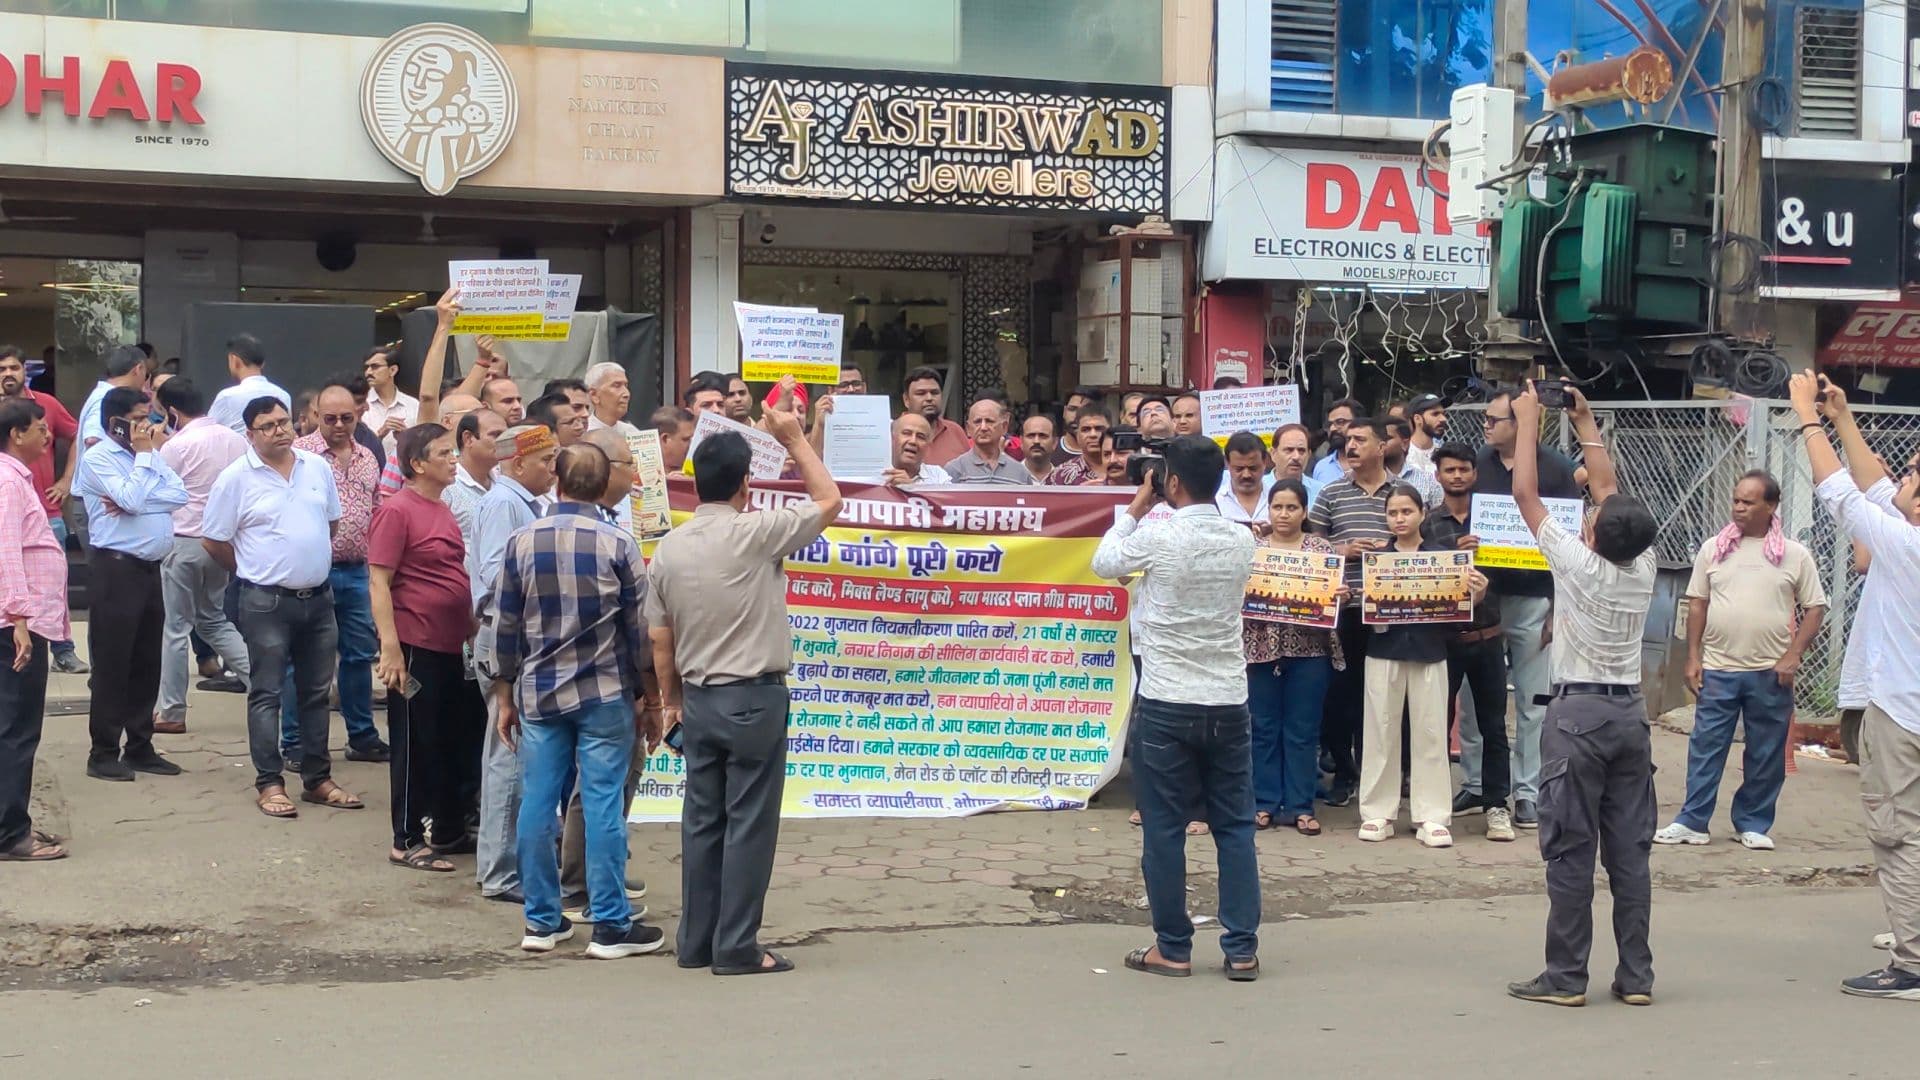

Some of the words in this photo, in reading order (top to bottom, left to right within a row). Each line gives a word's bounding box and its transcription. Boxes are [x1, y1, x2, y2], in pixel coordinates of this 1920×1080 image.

[583, 75, 661, 91] SWEETS
[568, 97, 667, 115] NAMKEEN
[135, 135, 173, 144] SINCE
[181, 137, 210, 146] 1970
[587, 122, 655, 139] CHAAT
[842, 96, 1160, 158] ASHIRWAD
[582, 146, 662, 163] BAKERY
[907, 156, 1096, 198] Jewellers
[1776, 197, 1813, 246] &
[1254, 238, 1396, 260] ELECTRONICS
[1404, 244, 1416, 260] &
[1342, 266, 1458, 282] MODELS/PROJECT
[838, 497, 933, 528] यापारी
[941, 499, 1046, 532] महासंघ
[838, 536, 898, 567] मांगे
[907, 541, 948, 576] पूरी
[956, 544, 1003, 572] करो
[792, 575, 808, 595] बंद
[841, 579, 872, 600] मिक्स
[905, 588, 928, 610] लागू
[959, 590, 979, 607] नया
[982, 590, 1011, 607] मास्टर
[1015, 591, 1041, 608] प्लान
[1068, 593, 1092, 615] लागू
[788, 614, 819, 630] 2022
[824, 617, 868, 635] गुजरात
[872, 616, 952, 637] नियमतीकरण
[957, 620, 987, 639] पारित
[1023, 626, 1036, 639] 21
[1066, 623, 1077, 641] से
[1080, 628, 1118, 643] मास्टर
[844, 643, 875, 658] नगर
[877, 641, 916, 659] निगम
[918, 641, 935, 660] की
[937, 643, 978, 661] सीलिंग
[979, 643, 1029, 663] कार्यवाही
[1031, 647, 1048, 663] बंद
[1081, 649, 1116, 667] हमारी
[797, 660, 829, 681] बुढ़ापे
[832, 665, 849, 680] का
[852, 668, 891, 685] सहारा,
[895, 666, 926, 684] हमारे
[928, 666, 980, 686] जीवनभर
[983, 668, 1000, 686] की
[1003, 673, 1029, 688] जमा
[1033, 671, 1057, 693] पूंजी
[1059, 672, 1090, 690] हमसे
[1093, 677, 1113, 692] मत
[790, 684, 821, 702] करने
[824, 689, 838, 703] पर
[842, 690, 881, 710] मजबूर
[883, 693, 903, 706] मत
[937, 693, 957, 708] हम
[1017, 693, 1028, 712] ने
[1031, 701, 1065, 713] अपना
[1068, 697, 1113, 716] रोजगार
[796, 708, 841, 728] रोजगार
[845, 710, 853, 728] दे
[857, 711, 881, 730] नही
[884, 713, 919, 731] सकते
[922, 714, 935, 731] तो
[938, 719, 962, 733] आप
[967, 721, 1000, 735] हमारा
[1004, 717, 1048, 736] रोजगार
[1052, 724, 1073, 737] मत
[863, 737, 895, 756] हमने
[898, 741, 940, 757] सरकार
[943, 739, 960, 758] को
[964, 742, 1030, 760] व्यवसायिक
[1032, 747, 1047, 761] दर
[1050, 748, 1067, 762] पर
[801, 763, 816, 778] दर
[819, 764, 834, 778] पर
[838, 764, 890, 783] भुगतान,
[894, 762, 917, 781] मेन
[920, 763, 939, 782] रोड
[943, 763, 955, 782] के
[959, 765, 987, 784] प्लॉट
[991, 764, 1007, 784] की
[1011, 767, 1051, 789] रजिस्ट्री
[1055, 773, 1071, 786] पर
[814, 793, 861, 808] समस्त
